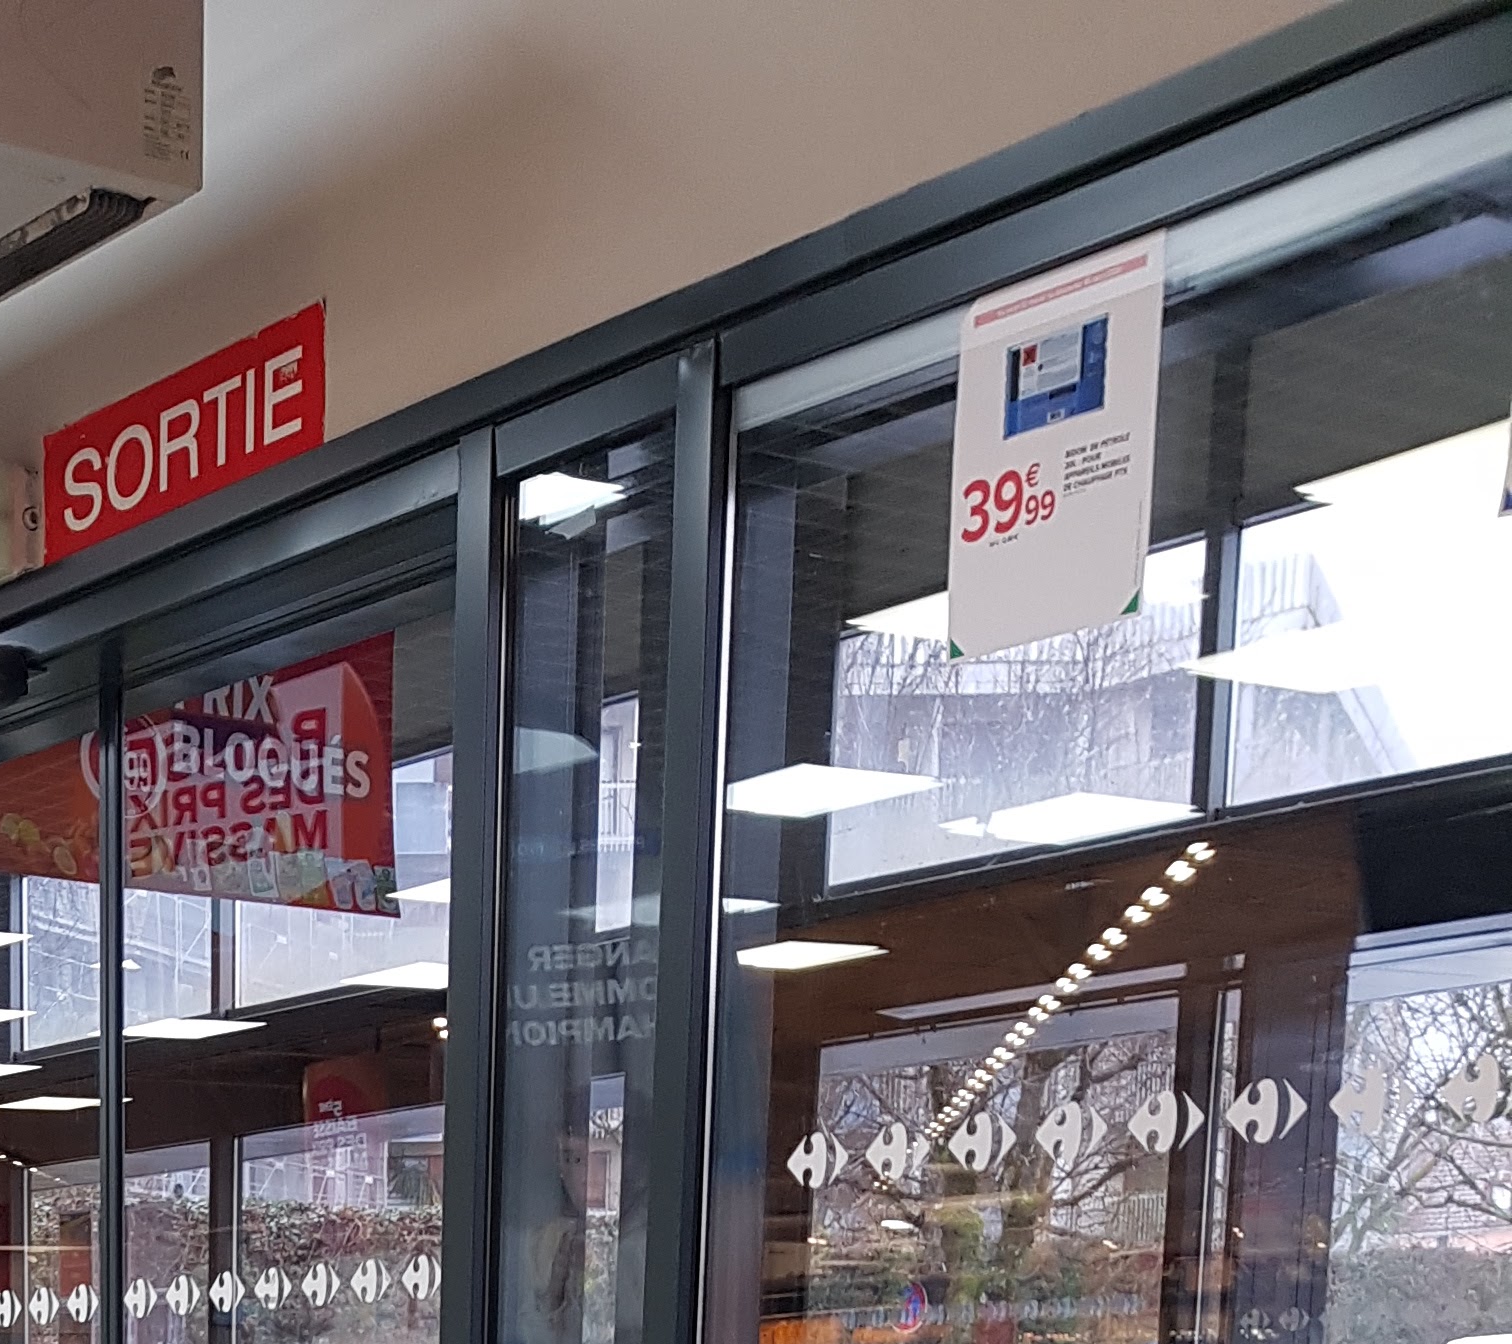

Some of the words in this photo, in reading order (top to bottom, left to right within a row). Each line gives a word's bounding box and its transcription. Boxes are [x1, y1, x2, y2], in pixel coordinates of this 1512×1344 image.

[63, 346, 304, 532] SORTIE
[1025, 462, 1040, 488] €
[961, 470, 1024, 543] 39
[1025, 490, 1056, 526] 99
[174, 675, 274, 725] RIX
[171, 718, 372, 799] BLOQUÉS
